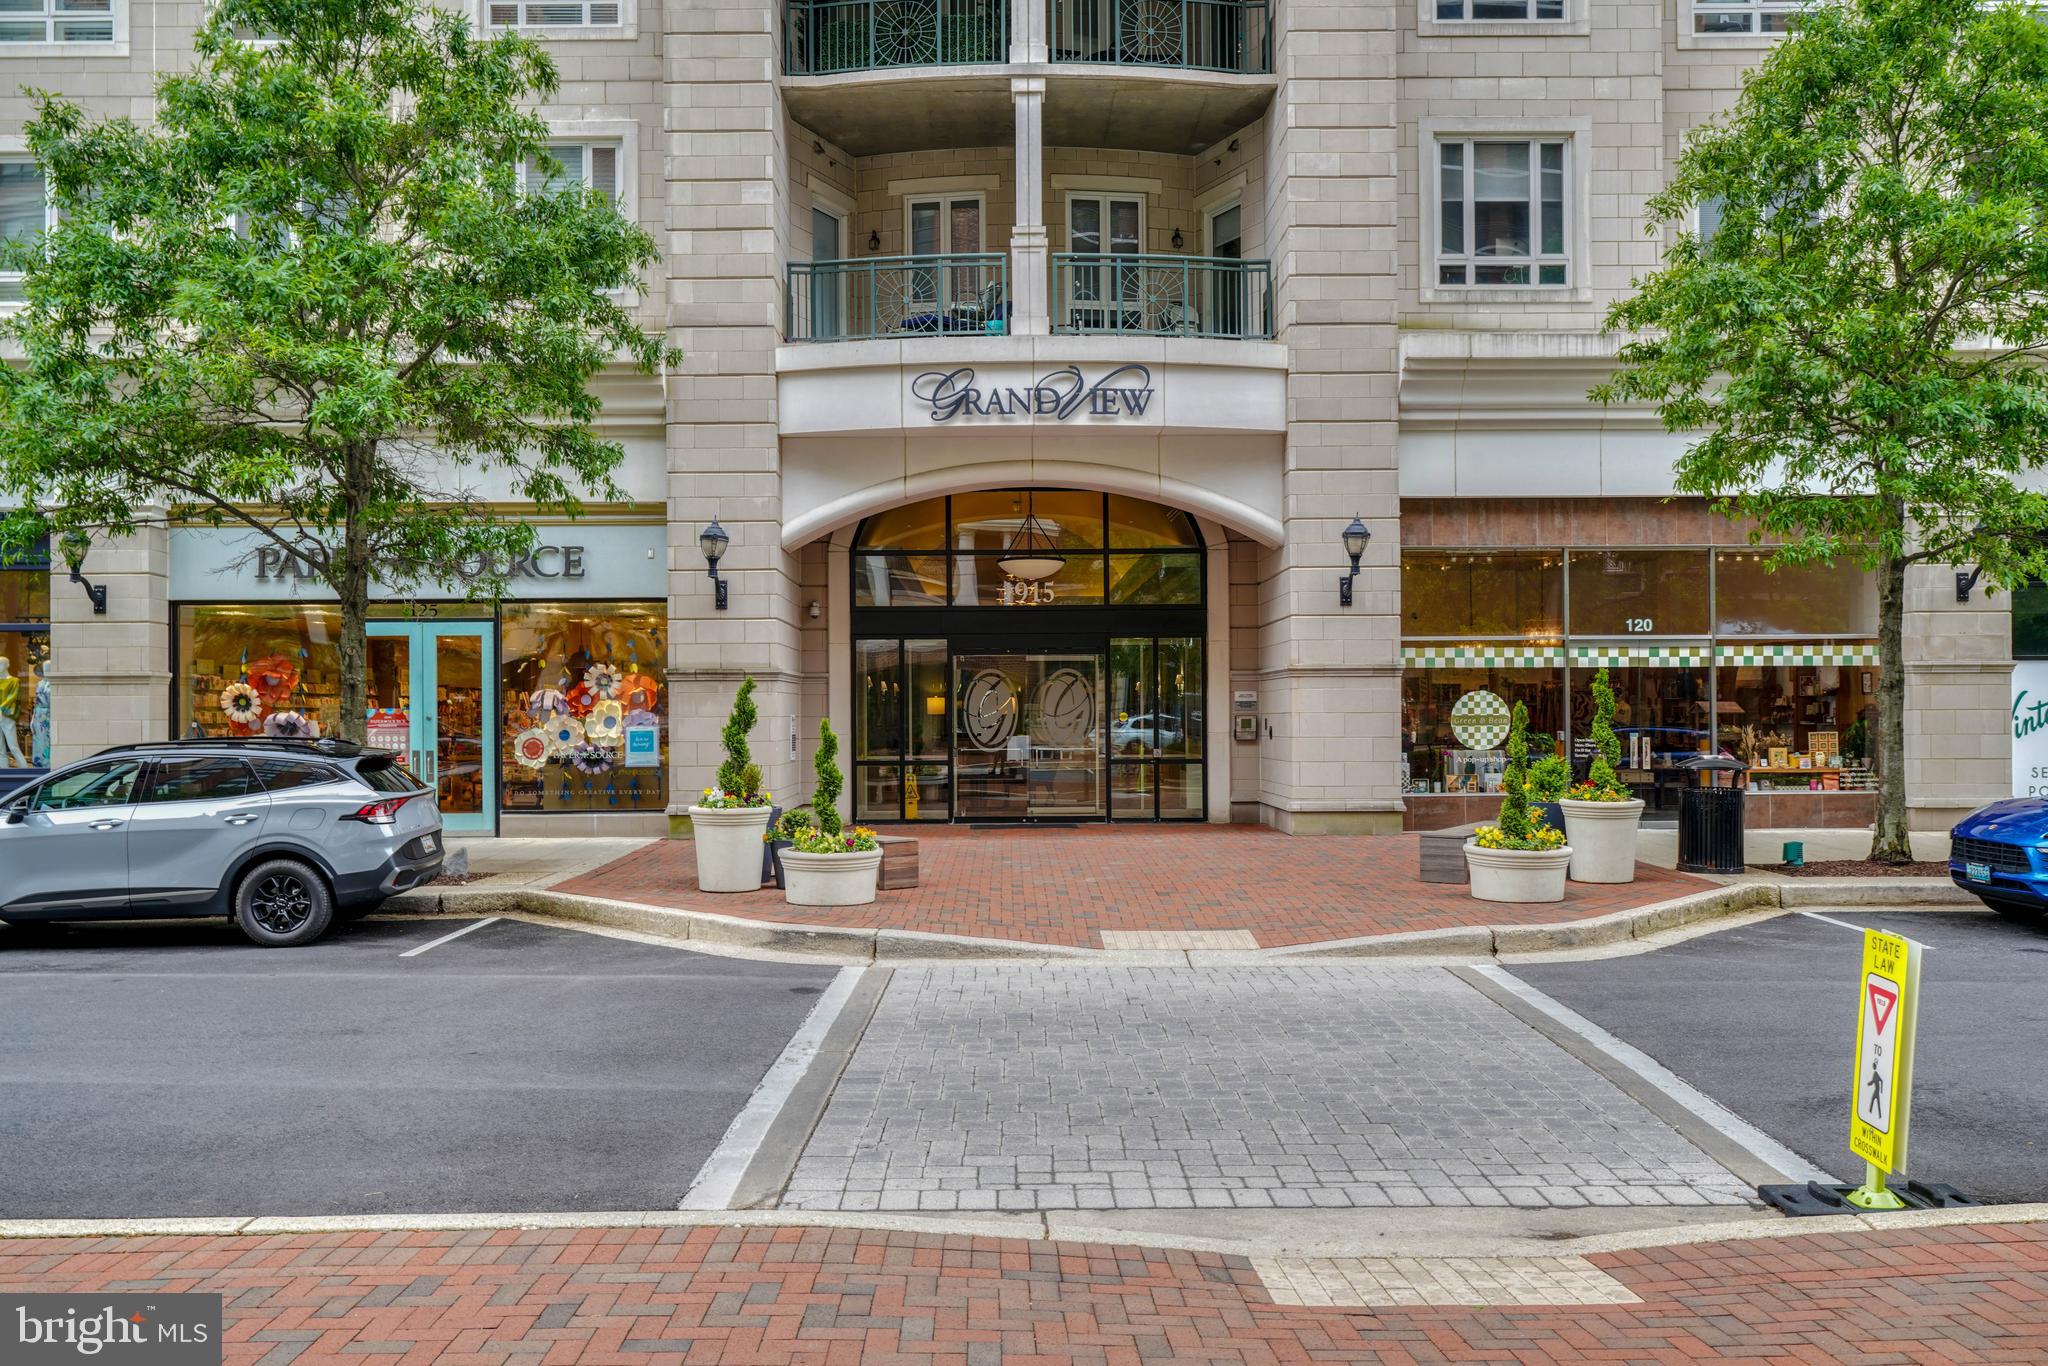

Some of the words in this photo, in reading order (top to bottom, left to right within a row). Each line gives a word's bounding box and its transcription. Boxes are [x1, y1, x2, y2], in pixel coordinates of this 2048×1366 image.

[255, 547, 365, 578] PAP
[1003, 581, 1055, 603] 1915
[411, 604, 438, 617] 125
[1626, 619, 1653, 631] 120
[1454, 717, 1477, 725] Green
[590, 751, 623, 759] SOURCE
[1488, 756, 1507, 764] shop
[1871, 936, 1901, 959] STATE
[1873, 954, 1895, 975] LAW
[1873, 1043, 1883, 1057] TO
[1862, 1126, 1882, 1148] WITHIN
[1854, 1136, 1888, 1166] CROSSWALK
